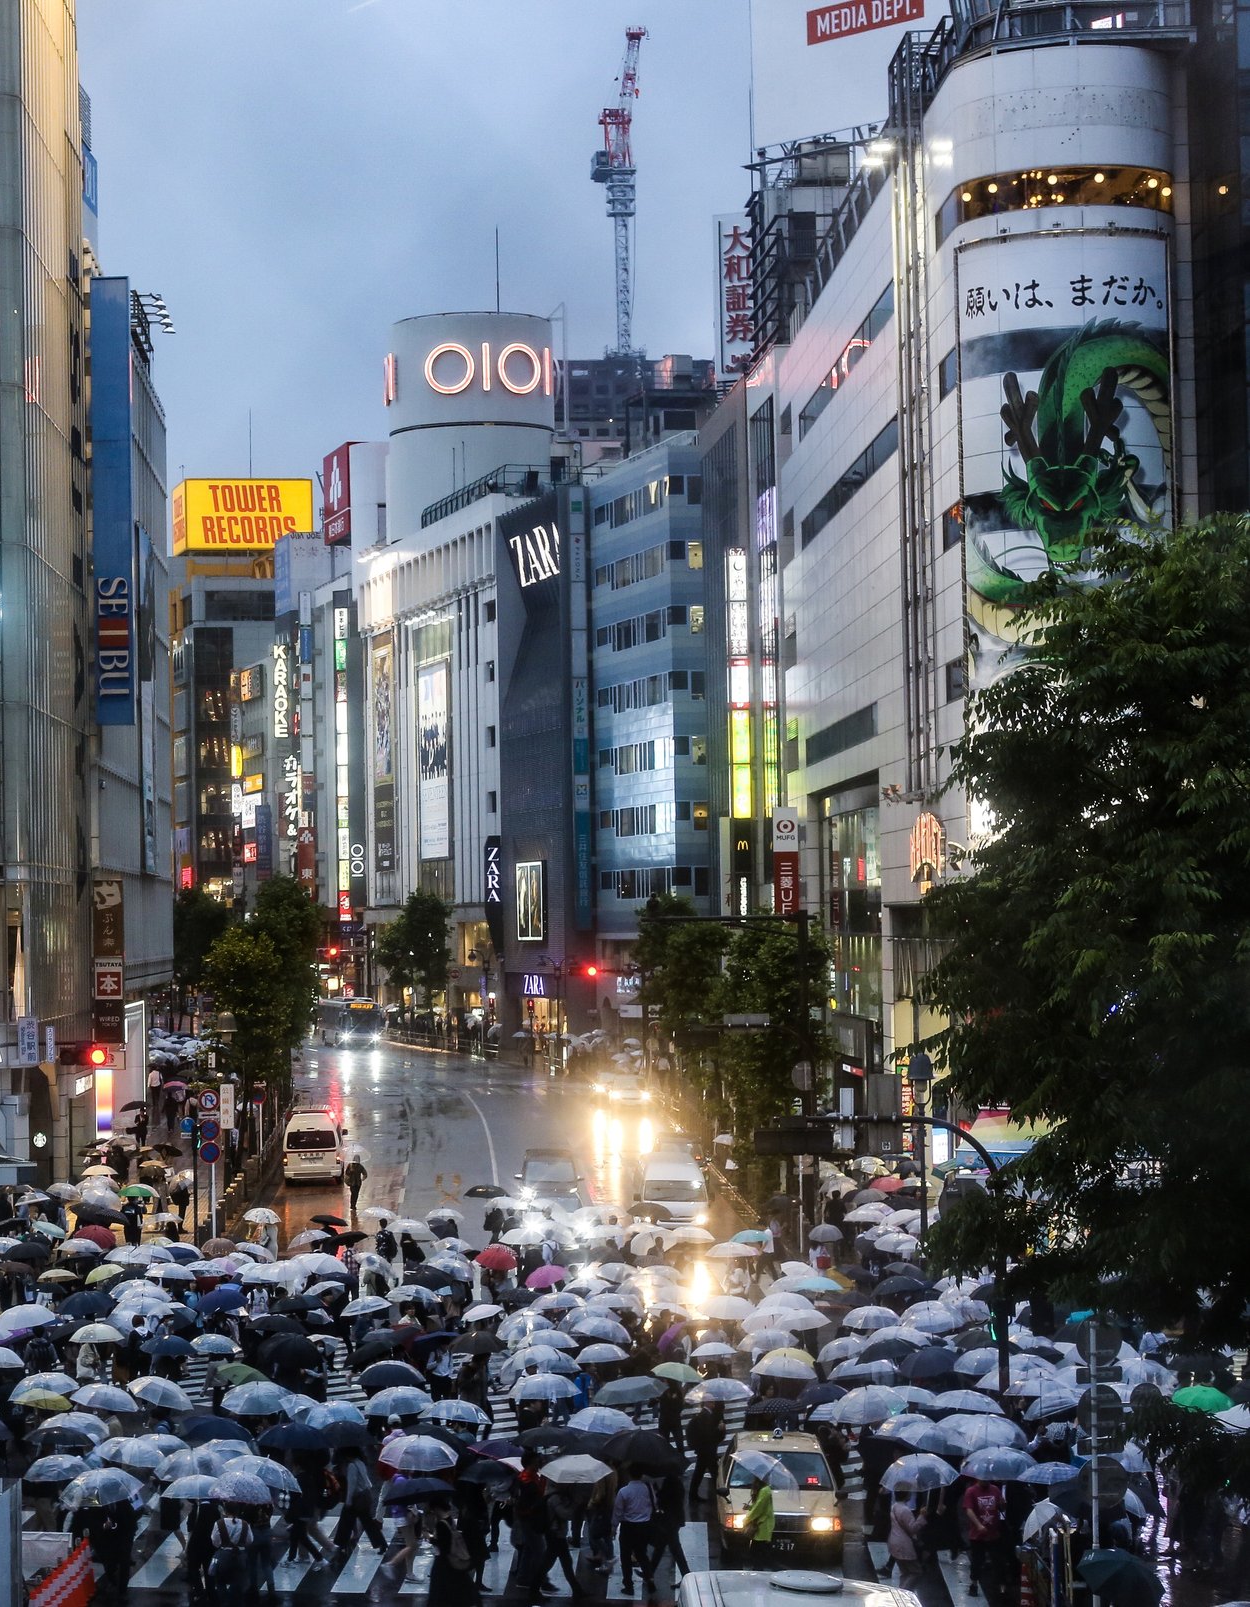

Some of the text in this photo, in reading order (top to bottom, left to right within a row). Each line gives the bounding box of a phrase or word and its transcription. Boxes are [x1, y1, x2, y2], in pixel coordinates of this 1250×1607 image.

[816, 0, 917, 37] MEDIA DEPT.
[723, 225, 754, 344] 大和証券
[965, 274, 1166, 319] 願いは、まだか。
[209, 484, 282, 512] TOWER
[202, 515, 297, 544] RECORDS
[97, 576, 129, 697] SEIBU
[273, 645, 289, 738] KARAOKE
[575, 680, 585, 723] パーソナル
[486, 847, 501, 902] ZARA
[780, 862, 793, 923] 三菱UF
[99, 974, 118, 994] 本
[523, 974, 545, 996] ZARA
[26, 1020, 37, 1062] 渋谷駅前
